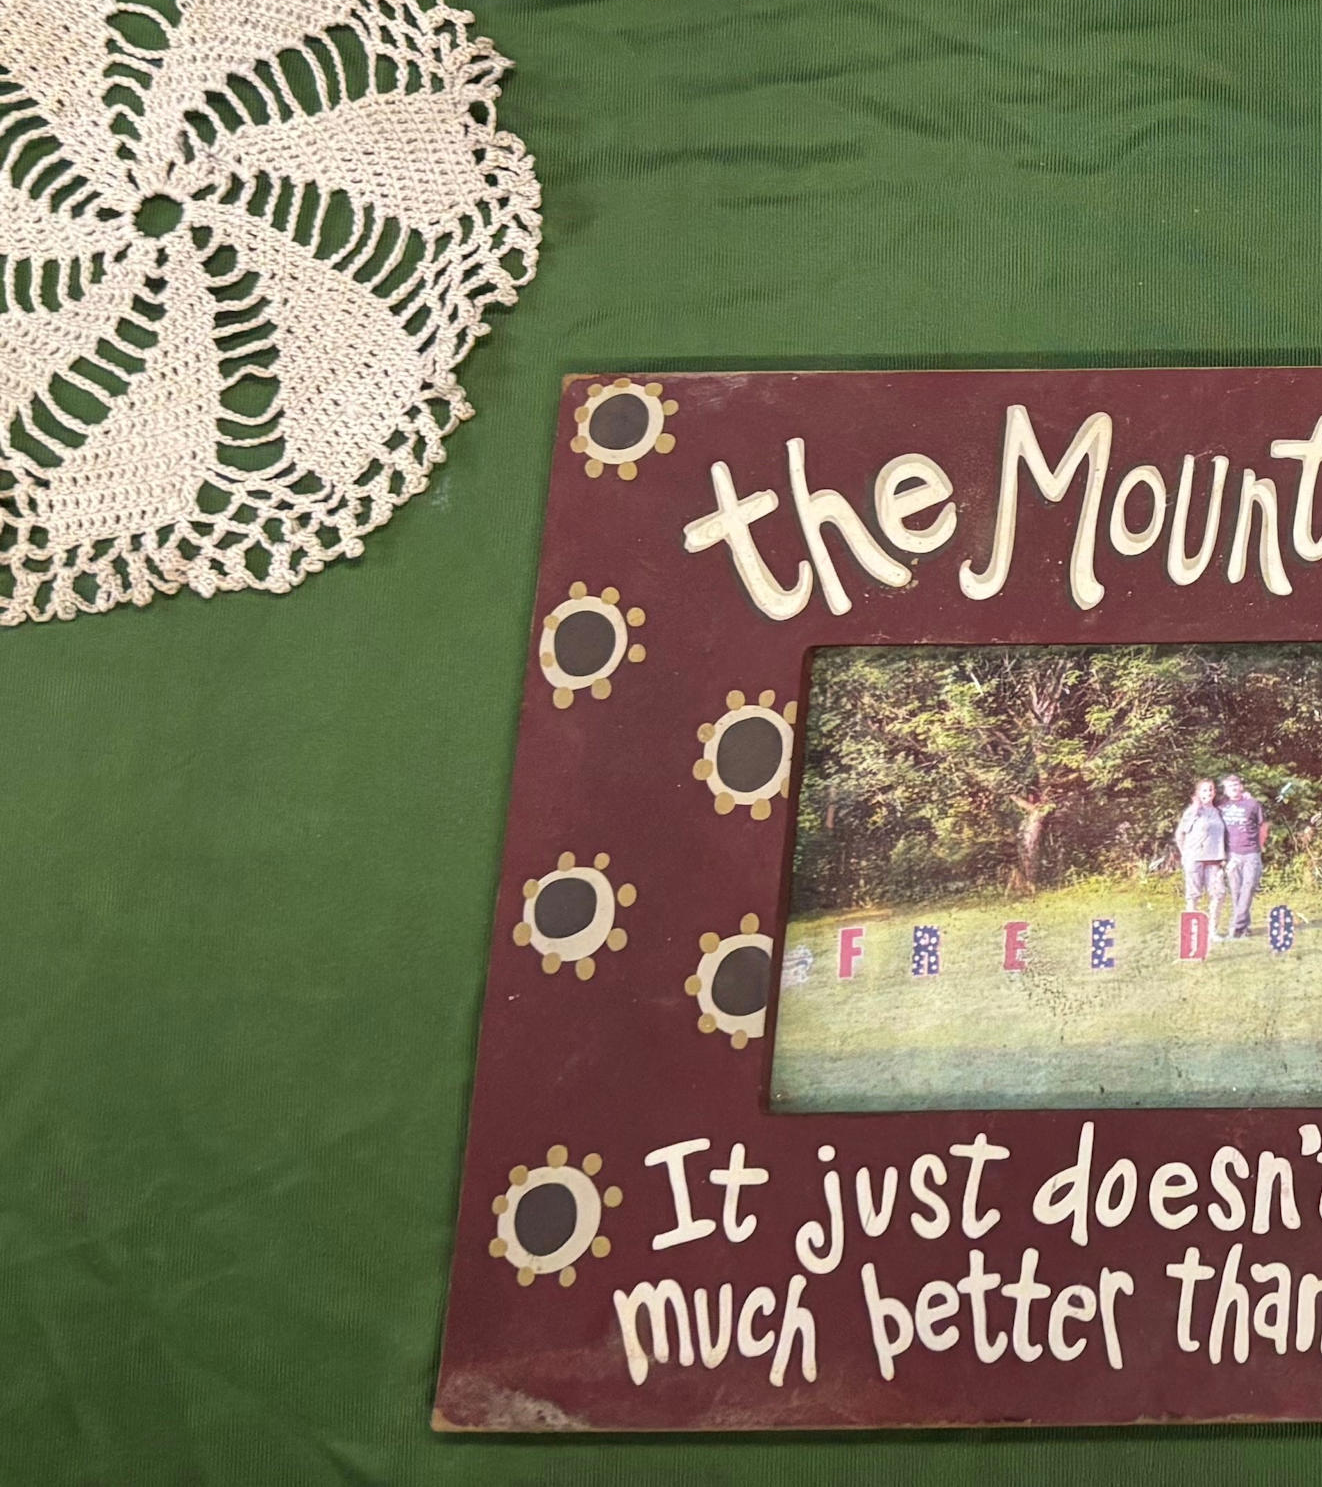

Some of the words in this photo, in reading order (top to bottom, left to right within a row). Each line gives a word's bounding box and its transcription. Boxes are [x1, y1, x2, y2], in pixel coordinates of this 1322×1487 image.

[682, 437, 958, 621] the
[643, 1137, 769, 1250] It
[796, 1132, 1010, 1276] just
[612, 1273, 816, 1387] much
[862, 1247, 1136, 1382] better
